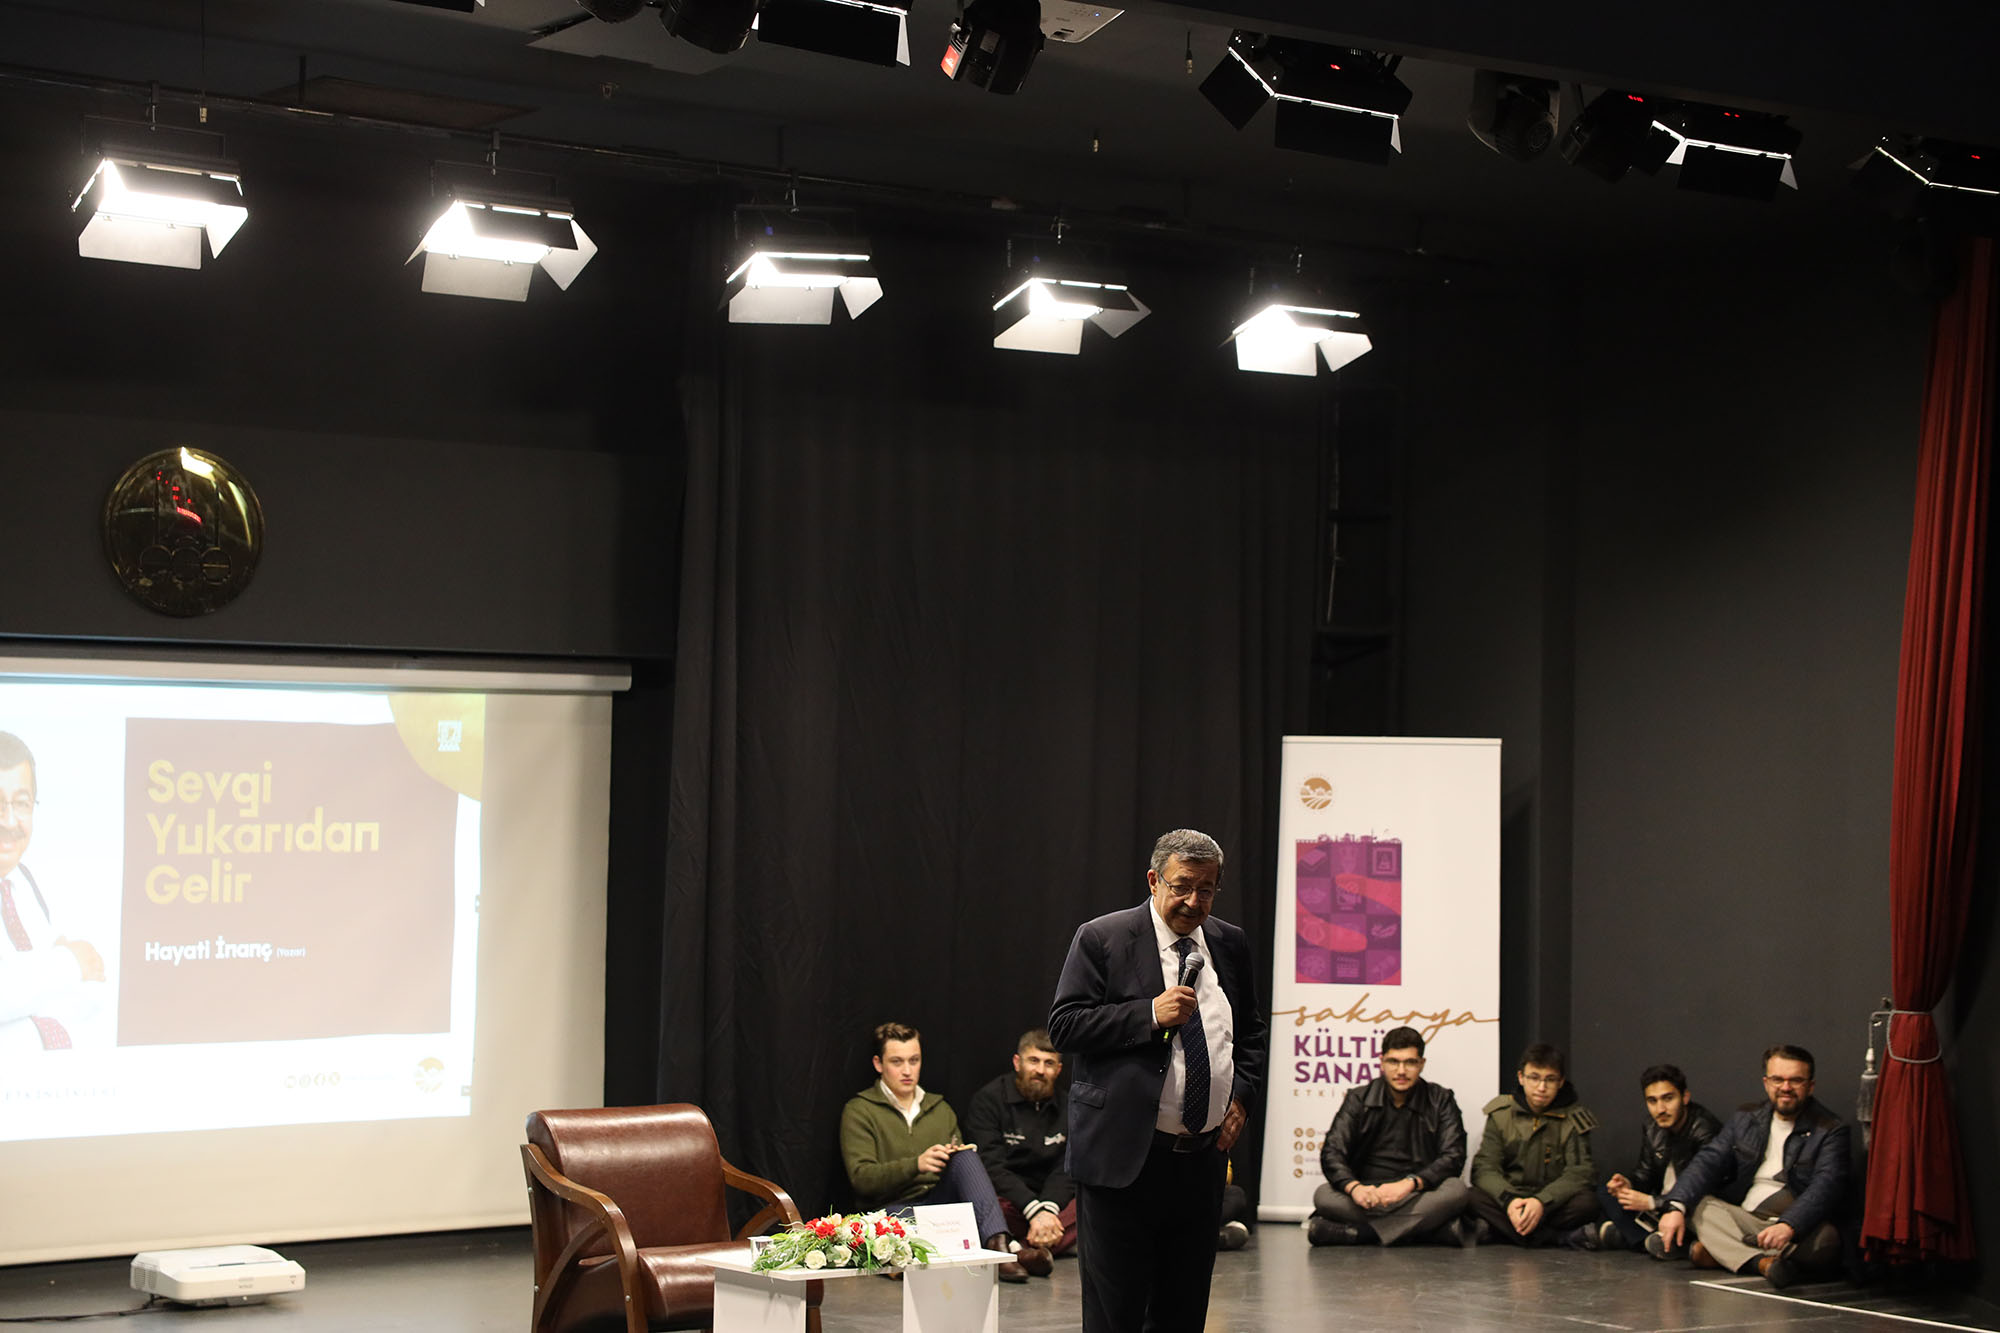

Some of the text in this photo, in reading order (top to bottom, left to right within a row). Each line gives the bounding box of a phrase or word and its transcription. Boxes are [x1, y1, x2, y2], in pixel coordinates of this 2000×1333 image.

[147, 760, 273, 817] Sevgi
[146, 806, 380, 855] Yukarıdan
[145, 858, 252, 905] Gelir
[145, 939, 210, 966] Hayati
[215, 935, 273, 963] İnanç
[1271, 992, 1500, 1045] sakarya
[1294, 1028, 1385, 1059] KÜLTÜ
